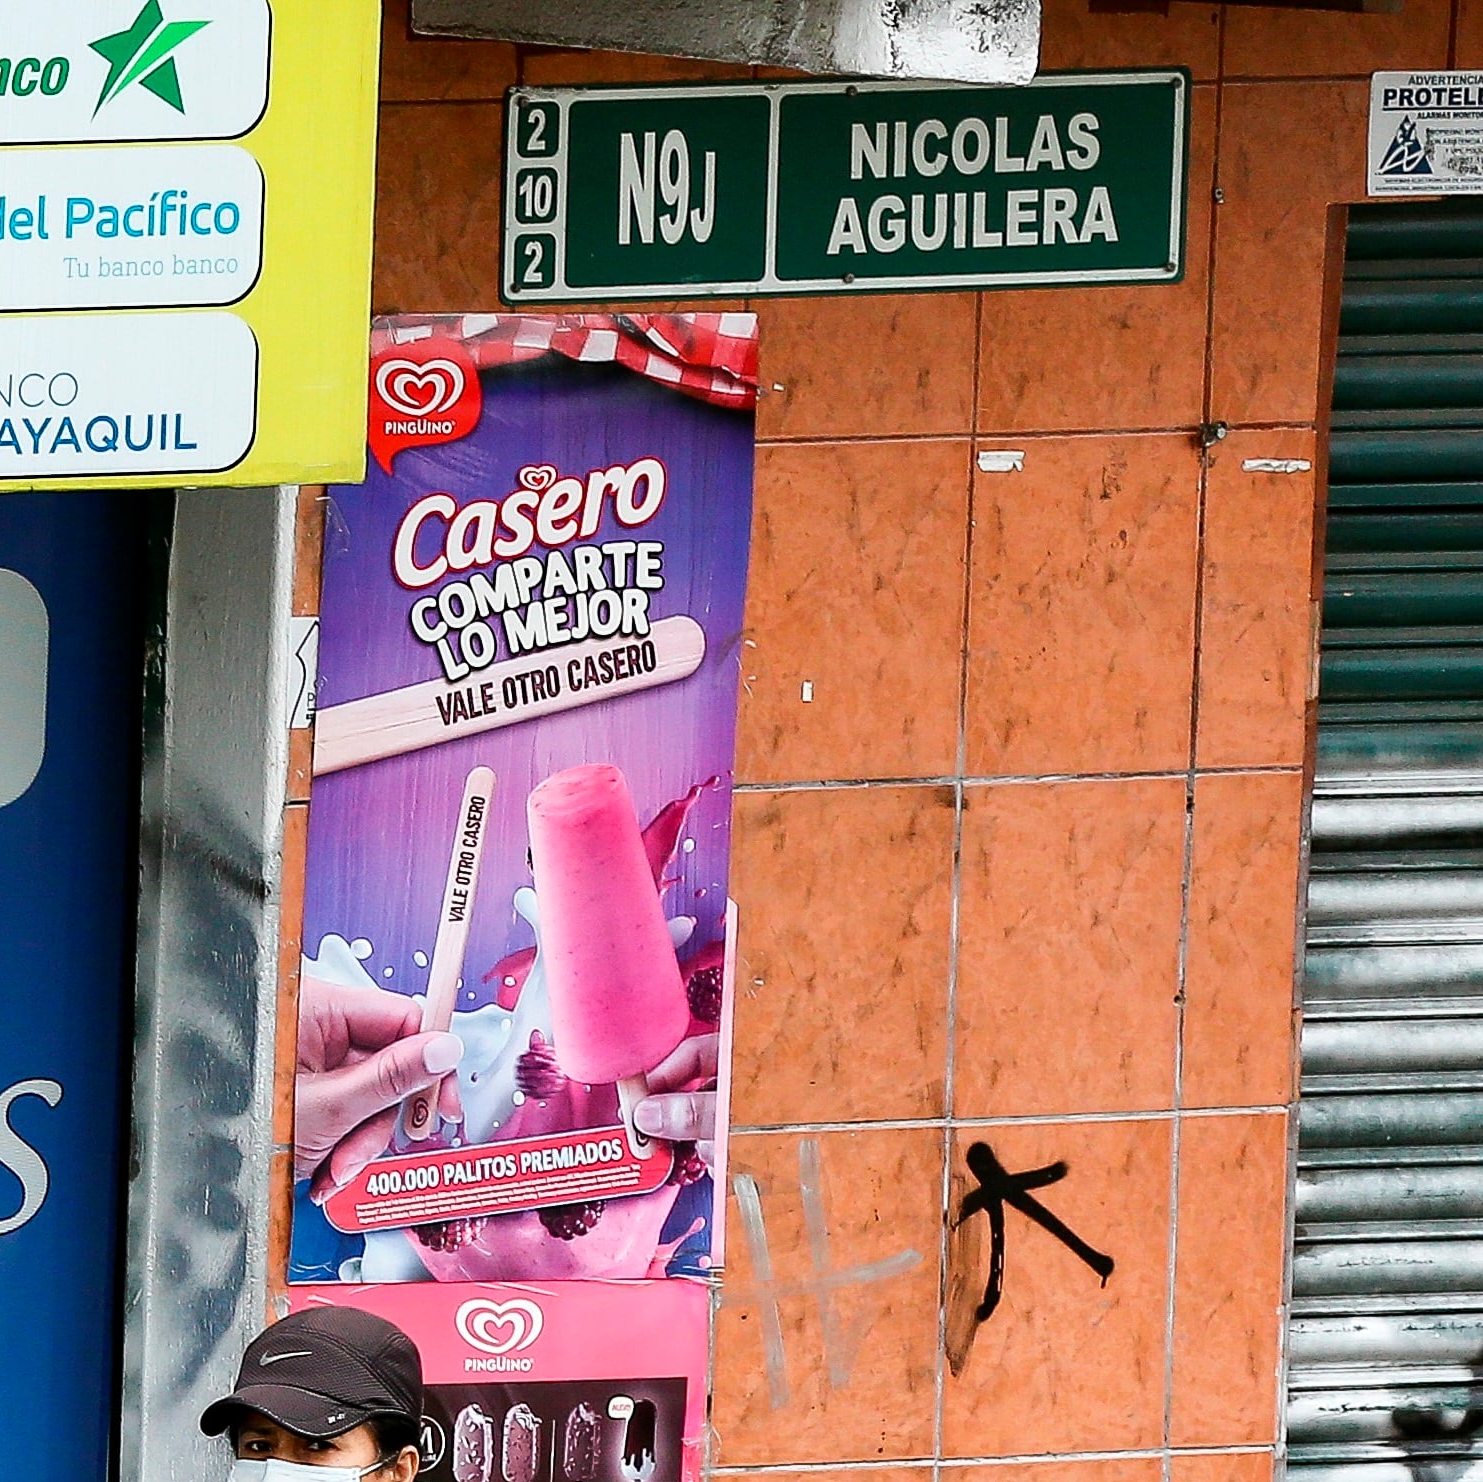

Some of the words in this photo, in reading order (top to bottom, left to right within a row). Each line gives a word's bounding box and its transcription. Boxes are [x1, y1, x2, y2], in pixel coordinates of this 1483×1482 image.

[526, 108, 546, 151] 2
[850, 112, 1101, 180] NICOLAS
[65, 189, 239, 239] Pacífico
[519, 173, 553, 217] 10
[618, 129, 716, 248] N9J
[826, 186, 1120, 256] AGUILERA
[63, 257, 90, 279] Tu
[98, 256, 164, 277] banco
[171, 254, 239, 275] banco
[524, 241, 543, 284] 2
[384, 418, 454, 435] PINGÜINO
[393, 456, 667, 589] Casero
[410, 541, 665, 643] COMPARTE
[435, 622, 496, 682] LO
[504, 589, 651, 657] MEJOR
[436, 680, 497, 727] VALE
[502, 665, 560, 710] OTRO
[567, 640, 658, 693] CASERO
[461, 795, 487, 848] CASERO
[454, 848, 477, 887] OTRO
[448, 888, 470, 924] VALE
[366, 1168, 440, 1197] 400.000
[443, 1155, 518, 1186] PALITOS
[520, 1139, 624, 1175] PREMIADOS
[464, 1356, 535, 1373] PINGÜINO
